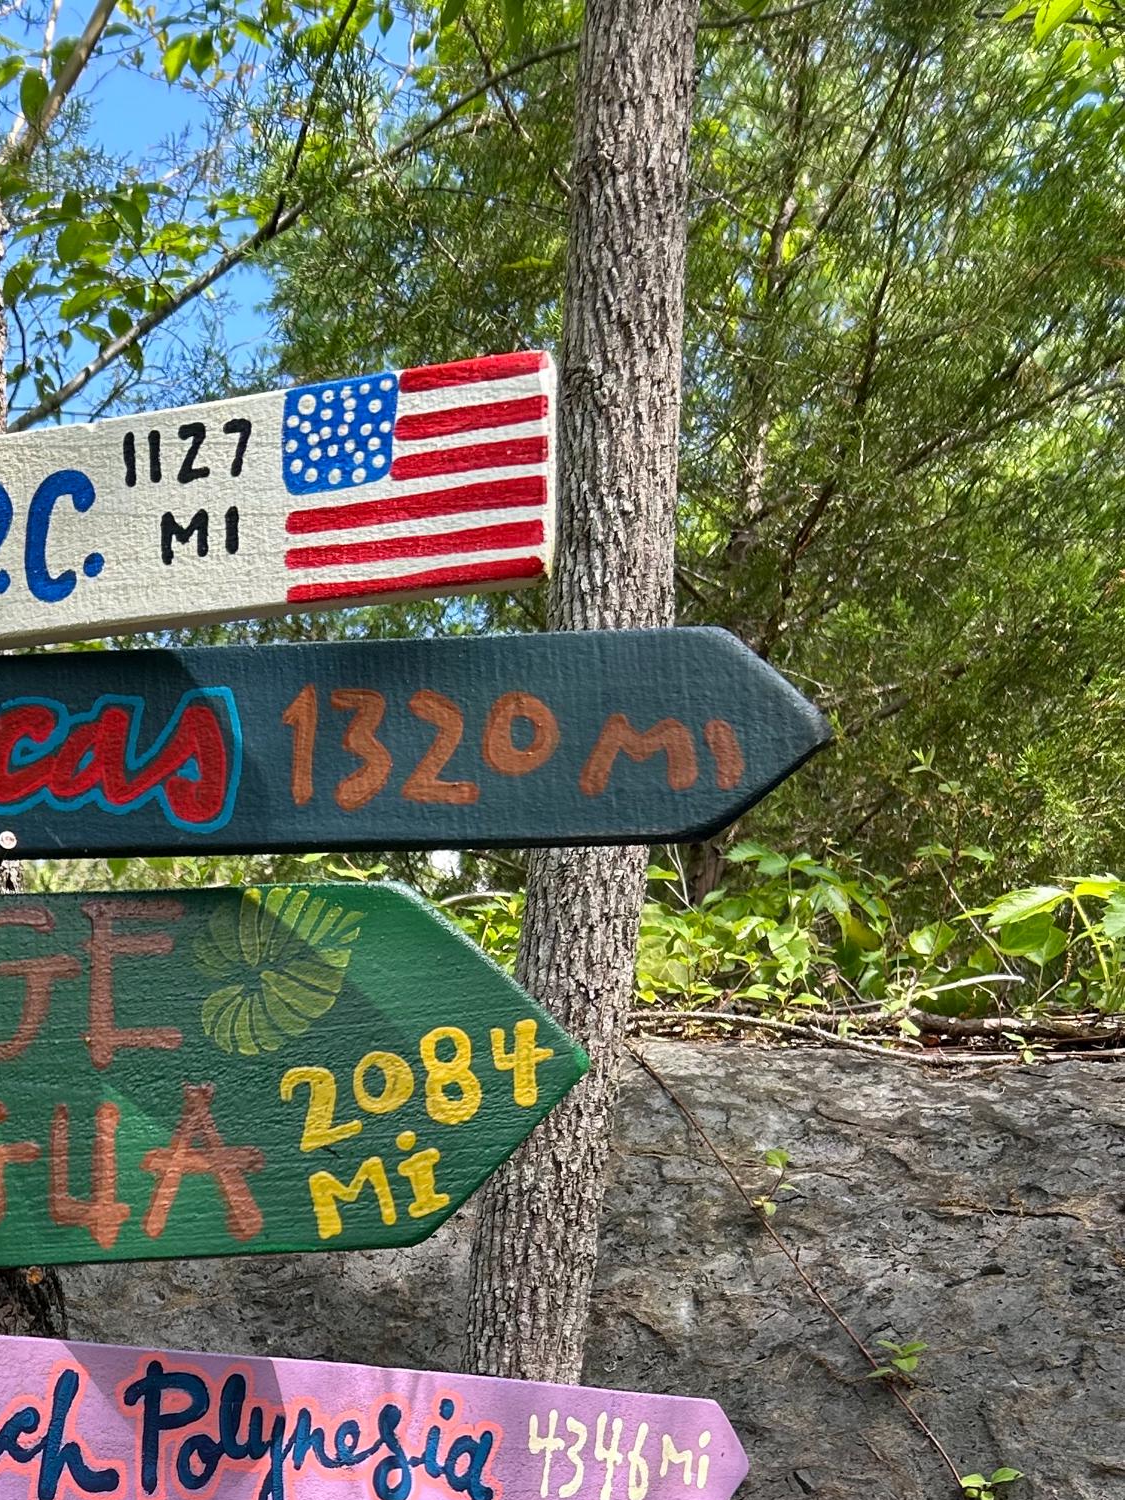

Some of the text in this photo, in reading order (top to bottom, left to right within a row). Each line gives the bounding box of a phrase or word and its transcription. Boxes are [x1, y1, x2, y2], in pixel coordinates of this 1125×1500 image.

[123, 418, 252, 486] 1127
[161, 506, 240, 565] MI
[282, 681, 562, 810] 1320
[278, 1017, 555, 1153] 2084
[307, 1129, 452, 1241] Mi
